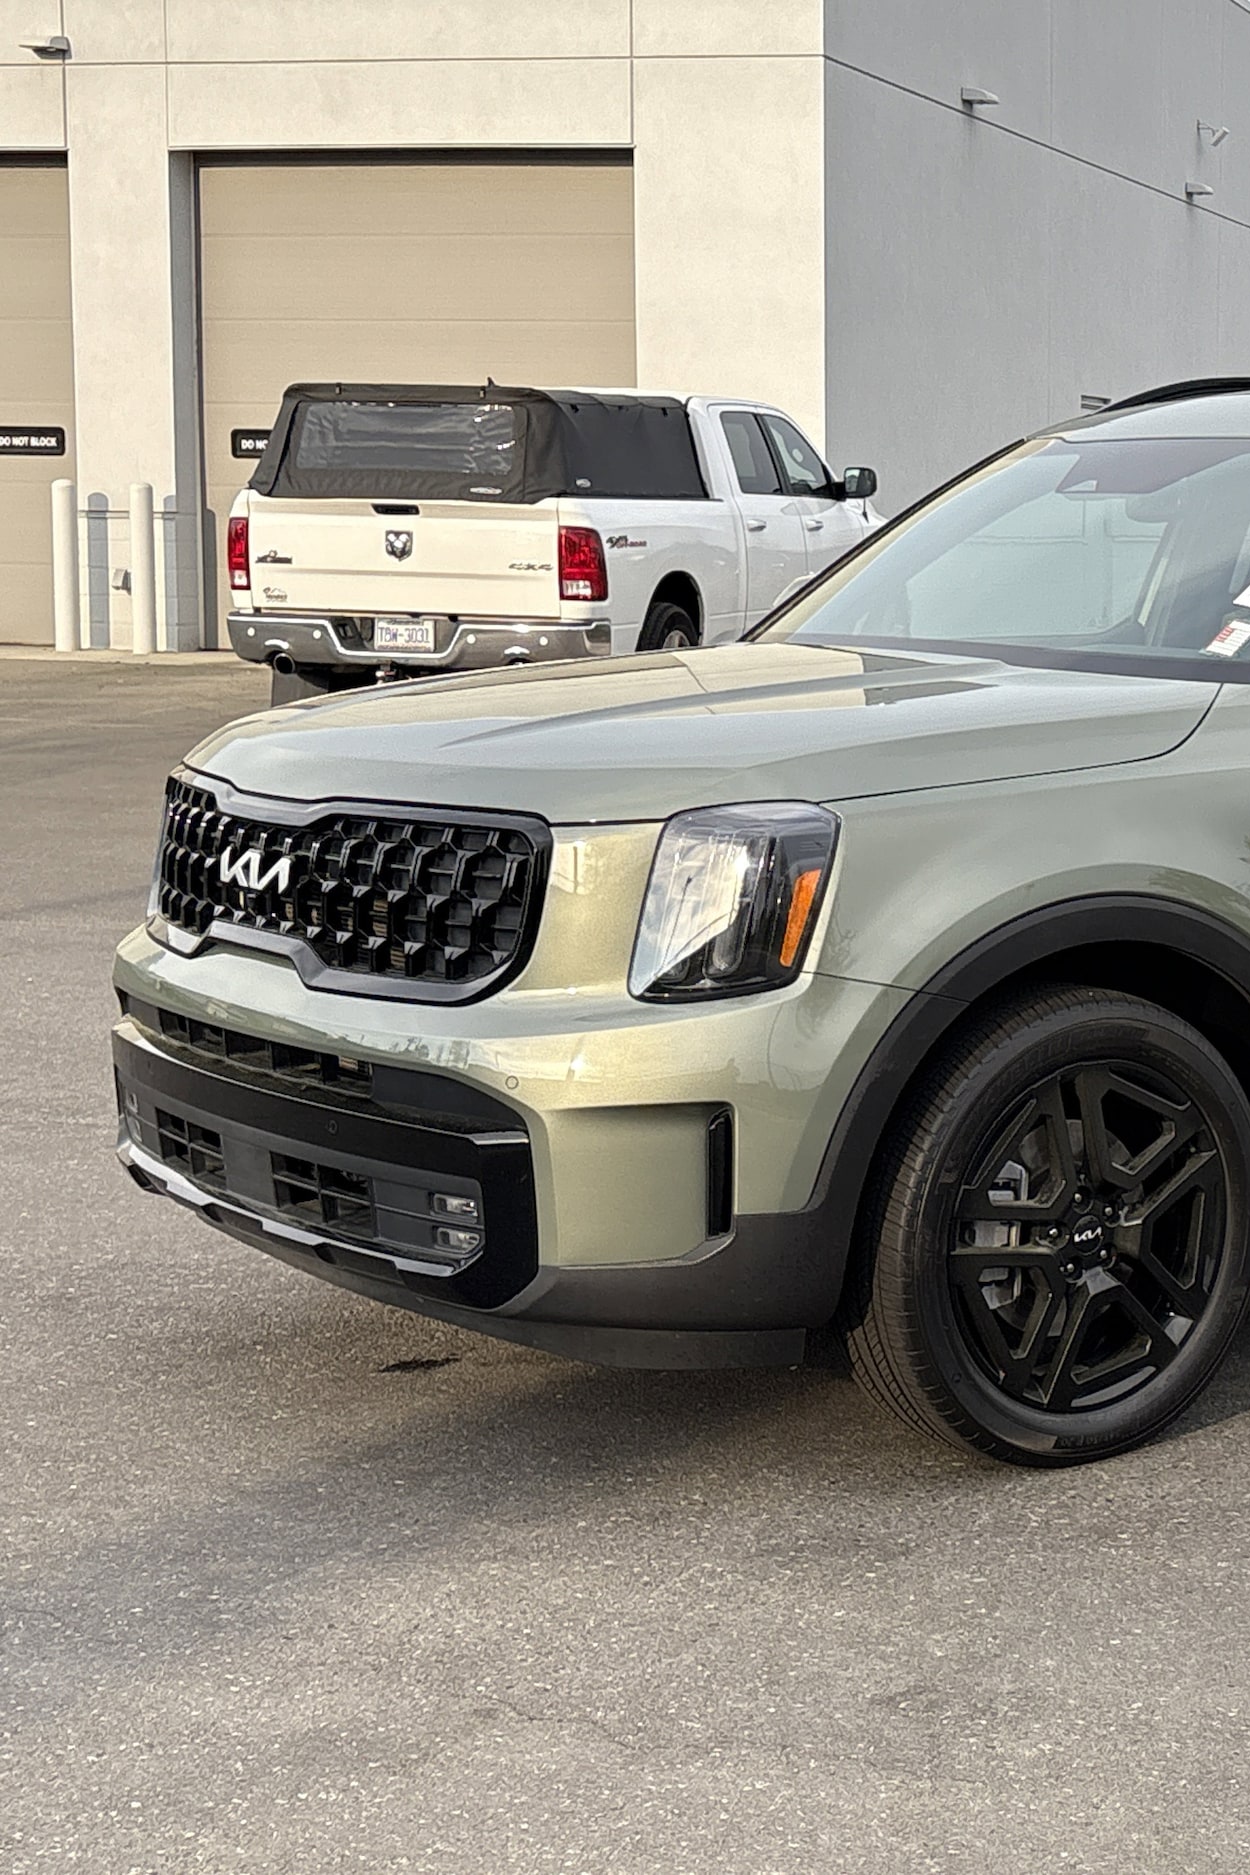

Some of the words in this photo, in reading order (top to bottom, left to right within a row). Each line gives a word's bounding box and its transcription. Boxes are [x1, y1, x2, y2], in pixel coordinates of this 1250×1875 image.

[12, 436, 29, 447] NOT
[30, 437, 58, 447] BLOCK
[241, 439, 255, 450] DO
